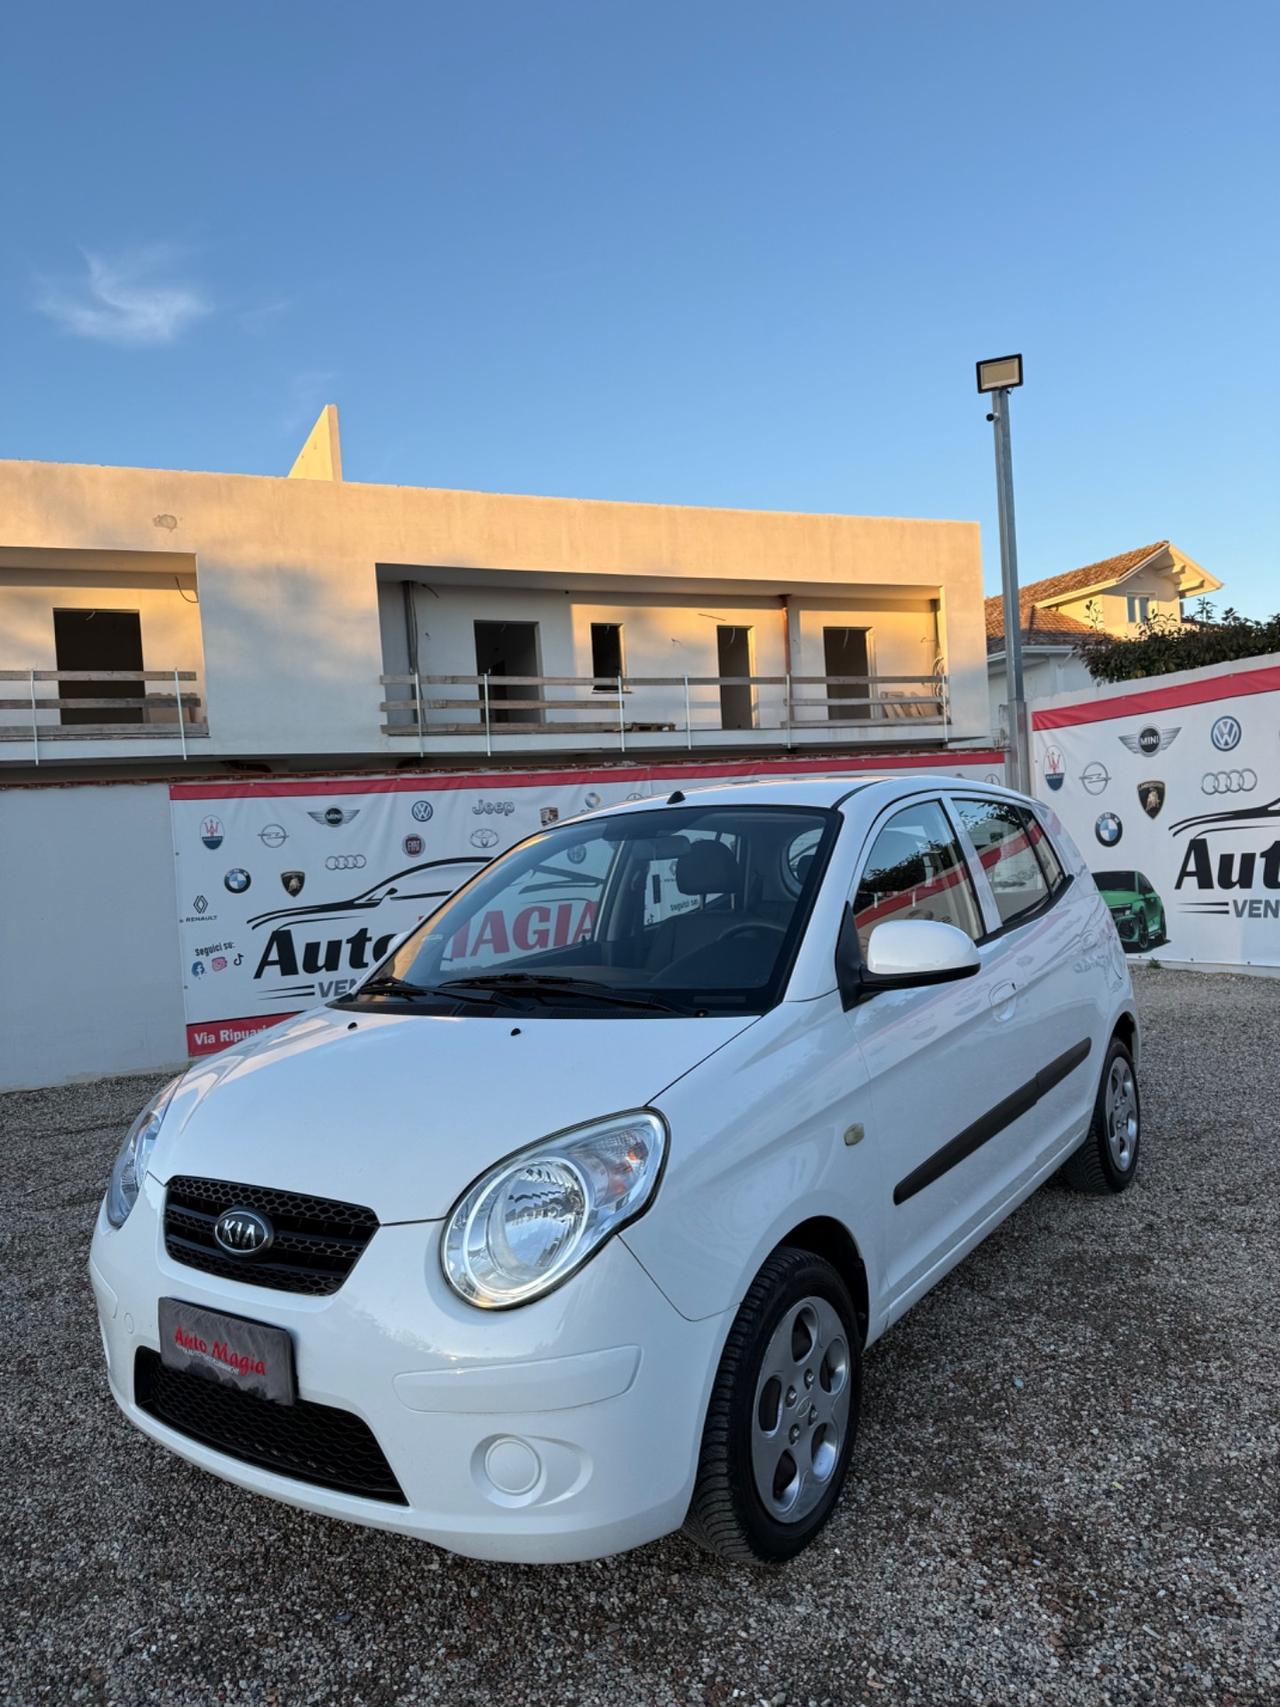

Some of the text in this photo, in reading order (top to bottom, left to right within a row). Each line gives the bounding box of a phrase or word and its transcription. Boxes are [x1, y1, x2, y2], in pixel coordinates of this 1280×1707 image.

[1140, 735, 1159, 745] MINI
[472, 799, 514, 816] Jeep
[194, 943, 222, 957] Seguici
[194, 1030, 216, 1046] Via
[223, 1219, 257, 1247] KIA
[175, 1326, 207, 1354] Auto
[212, 1340, 266, 1377] Magia
